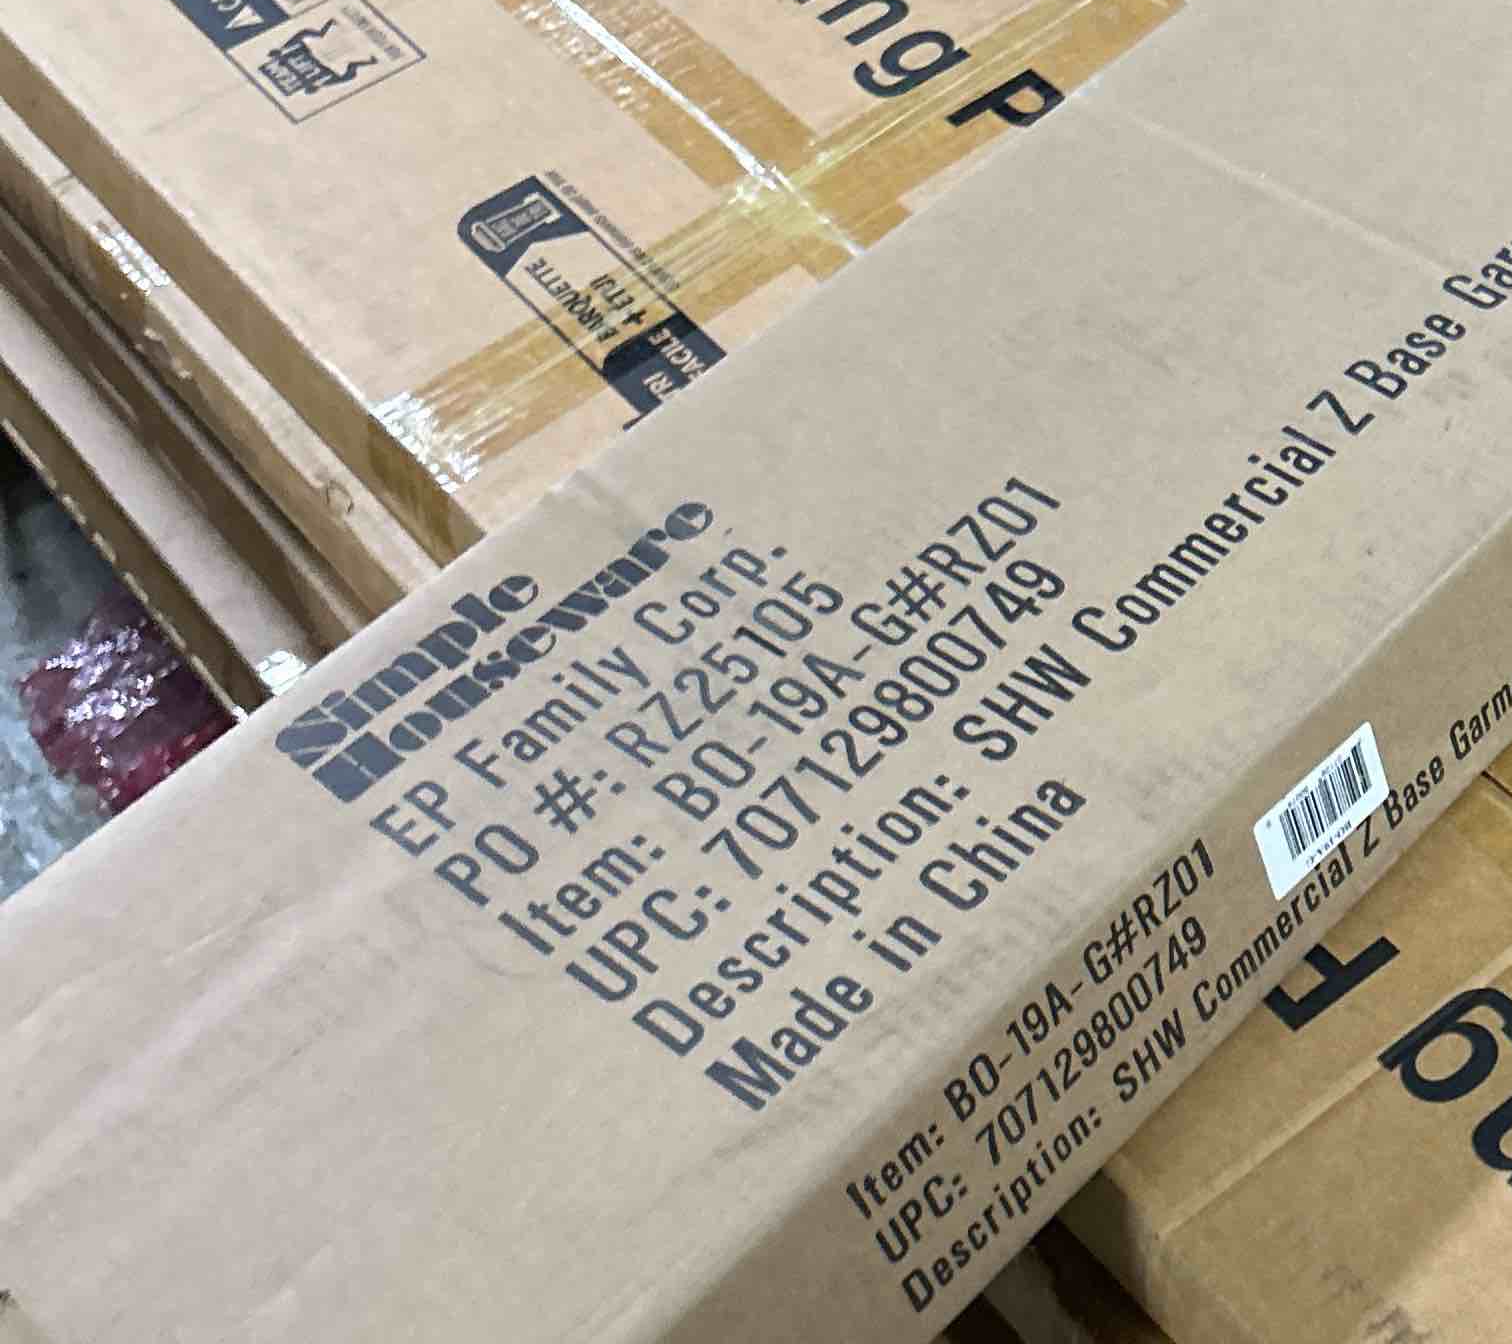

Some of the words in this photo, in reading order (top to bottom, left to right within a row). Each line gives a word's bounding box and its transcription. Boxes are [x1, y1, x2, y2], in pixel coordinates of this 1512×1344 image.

[275, 574, 540, 769] Simple
[312, 500, 714, 805] Houseware
[369, 781, 455, 858] EP
[454, 644, 653, 790] Family
[433, 821, 541, 908] PO
[533, 765, 631, 835] #:
[604, 570, 849, 769] RZ25105
[499, 832, 667, 958] Item:
[653, 474, 1063, 824] BO-19A-G#RZ01
[564, 882, 736, 1005] UPC:
[701, 558, 1070, 880] 707129800749
[631, 772, 974, 1059] Description:
[952, 643, 1095, 764] SHW
[1072, 423, 1338, 655] Commercial
[1307, 387, 1376, 435] Z
[1344, 308, 1469, 403] Base
[704, 973, 876, 1114] Made
[851, 913, 944, 975] in
[918, 775, 1089, 914] China
[844, 1122, 945, 1221] Item:
[942, 836, 1218, 1124] BO-19A-G#RZ01
[873, 1170, 970, 1266] UPC:
[975, 915, 1210, 1168] 707129800749
[900, 1102, 1105, 1315] Description:
[1112, 1008, 1188, 1105] SHW
[1190, 840, 1355, 1024] Commercial
[1355, 814, 1381, 858] Z
[1381, 755, 1446, 832] Base
